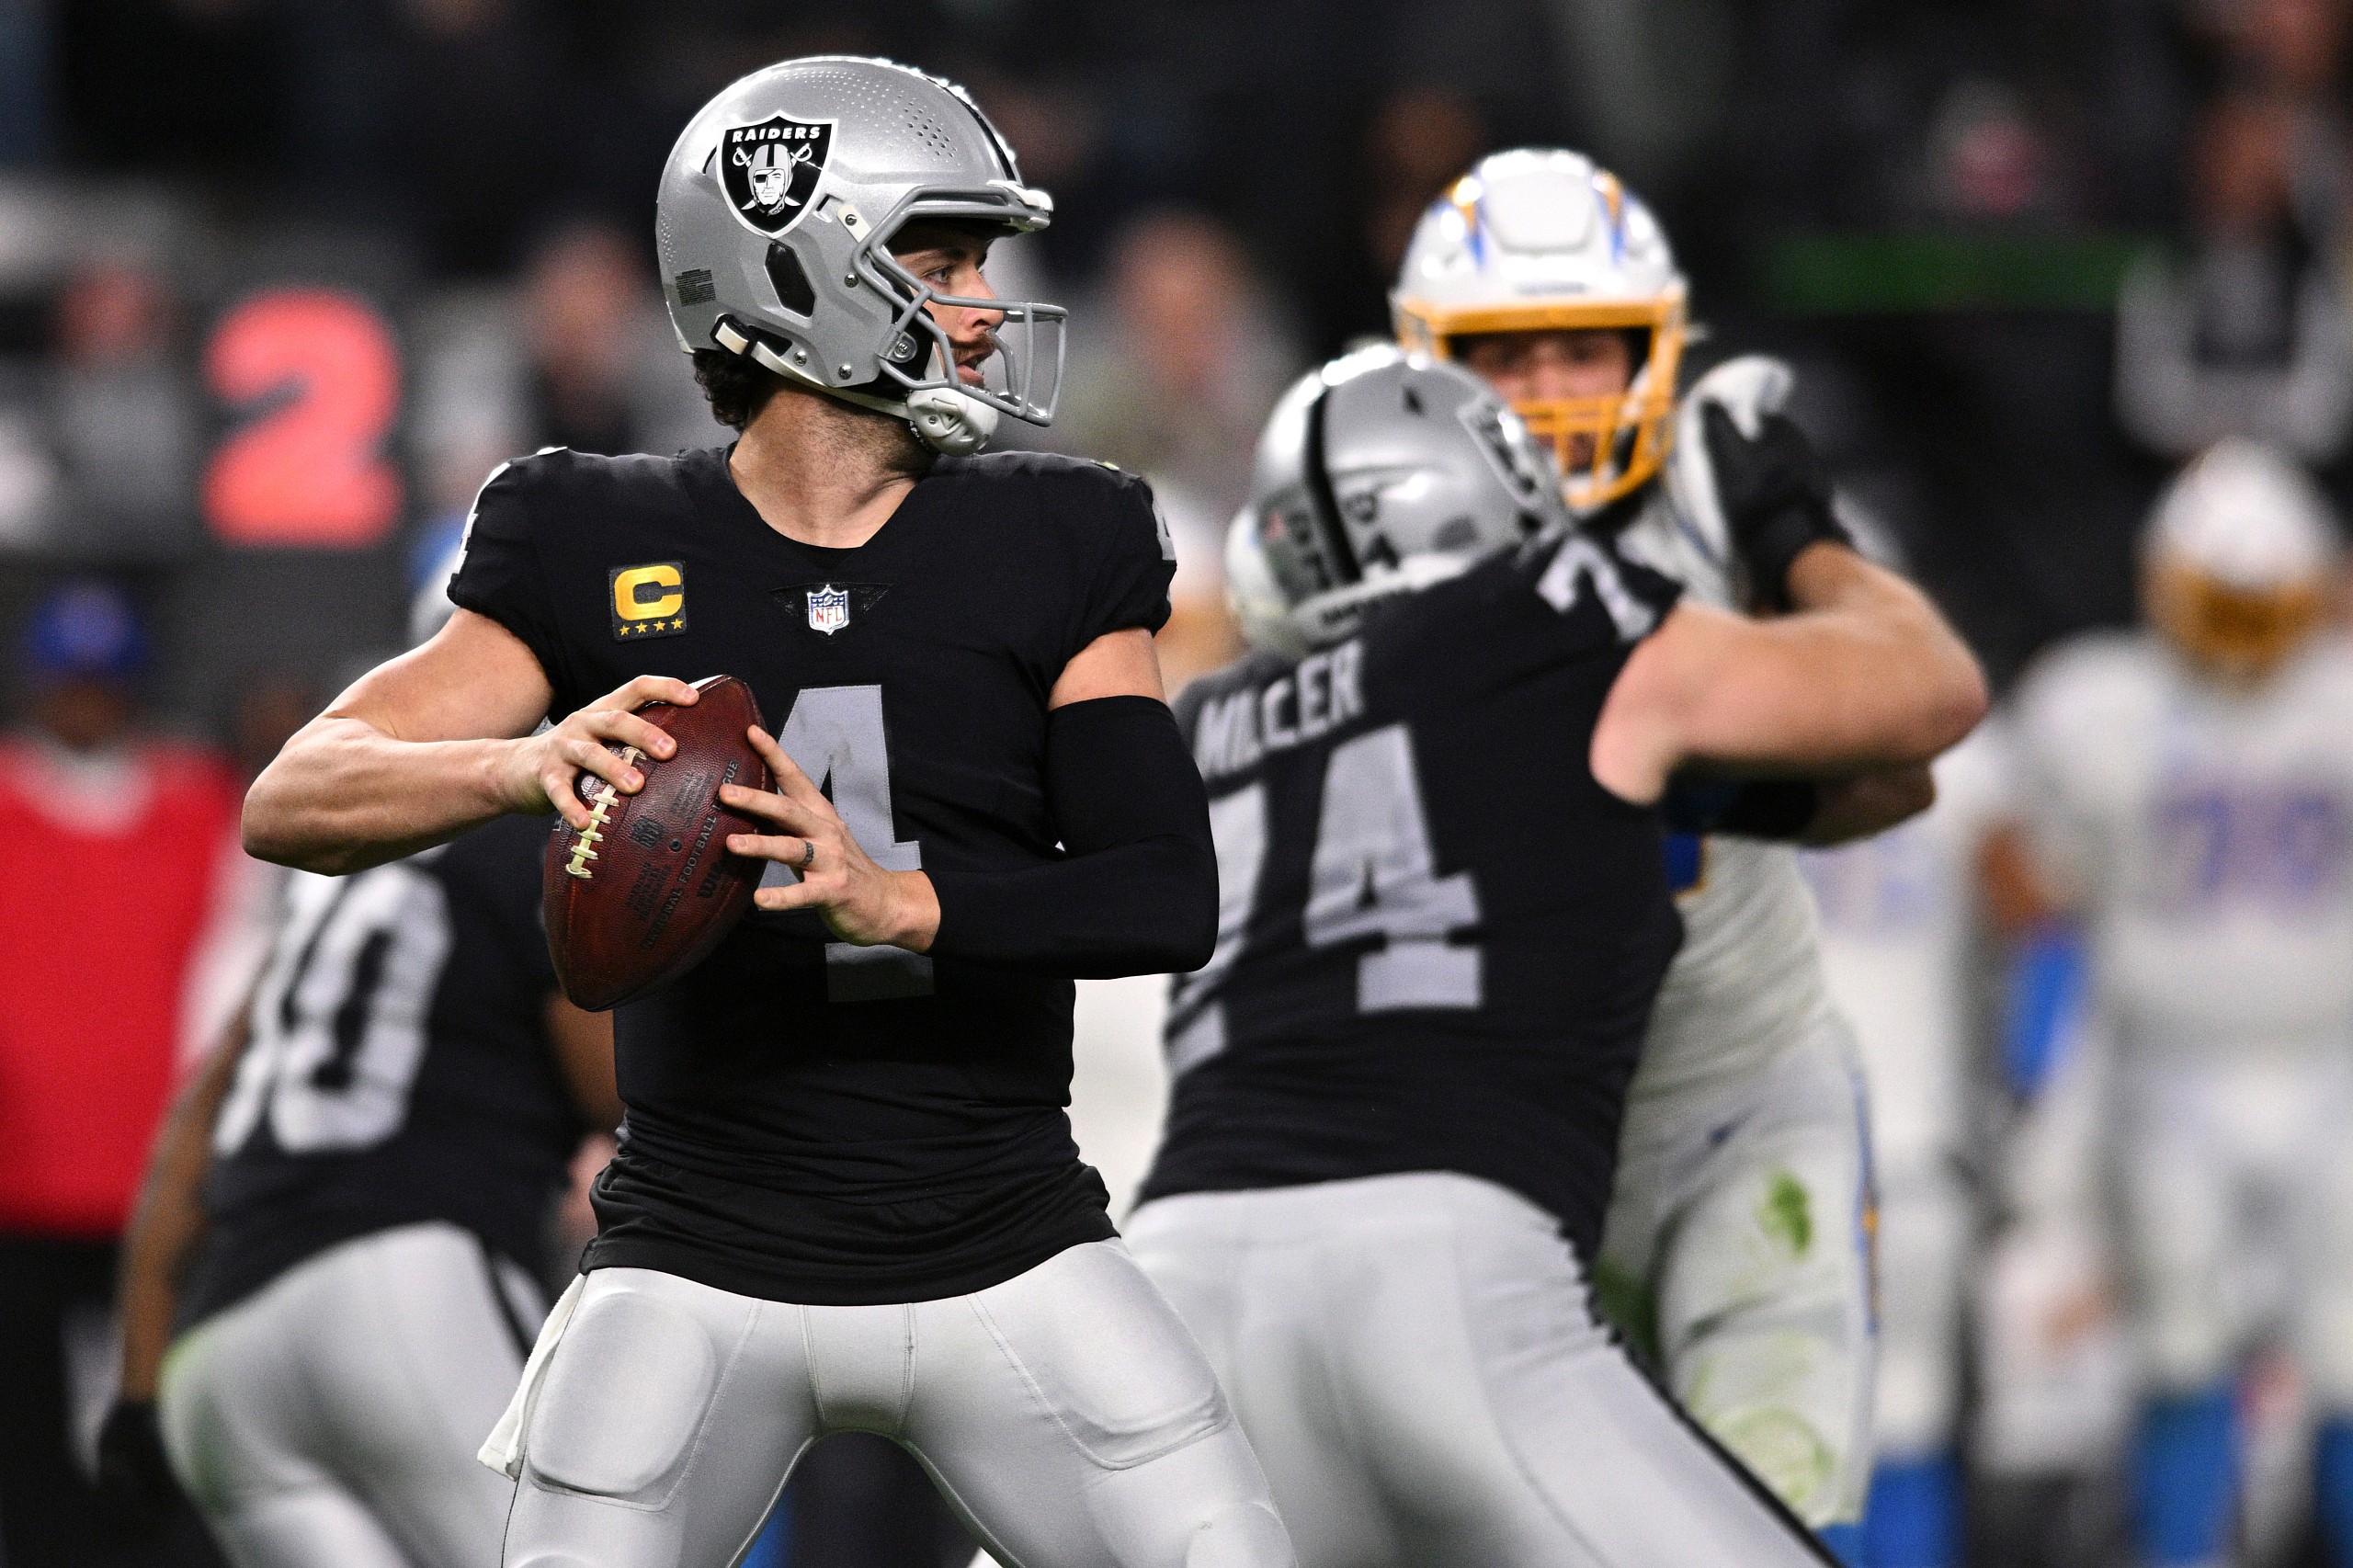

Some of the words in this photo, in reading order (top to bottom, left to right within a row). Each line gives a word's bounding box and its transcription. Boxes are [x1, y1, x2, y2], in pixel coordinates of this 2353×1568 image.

[732, 126, 821, 143] RAIDERS
[199, 283, 404, 549] 2
[614, 565, 683, 620] C
[811, 607, 842, 624] NFL
[678, 814, 717, 884] FOOTBALL
[712, 760, 739, 812] LGUE
[758, 685, 936, 1004] 4
